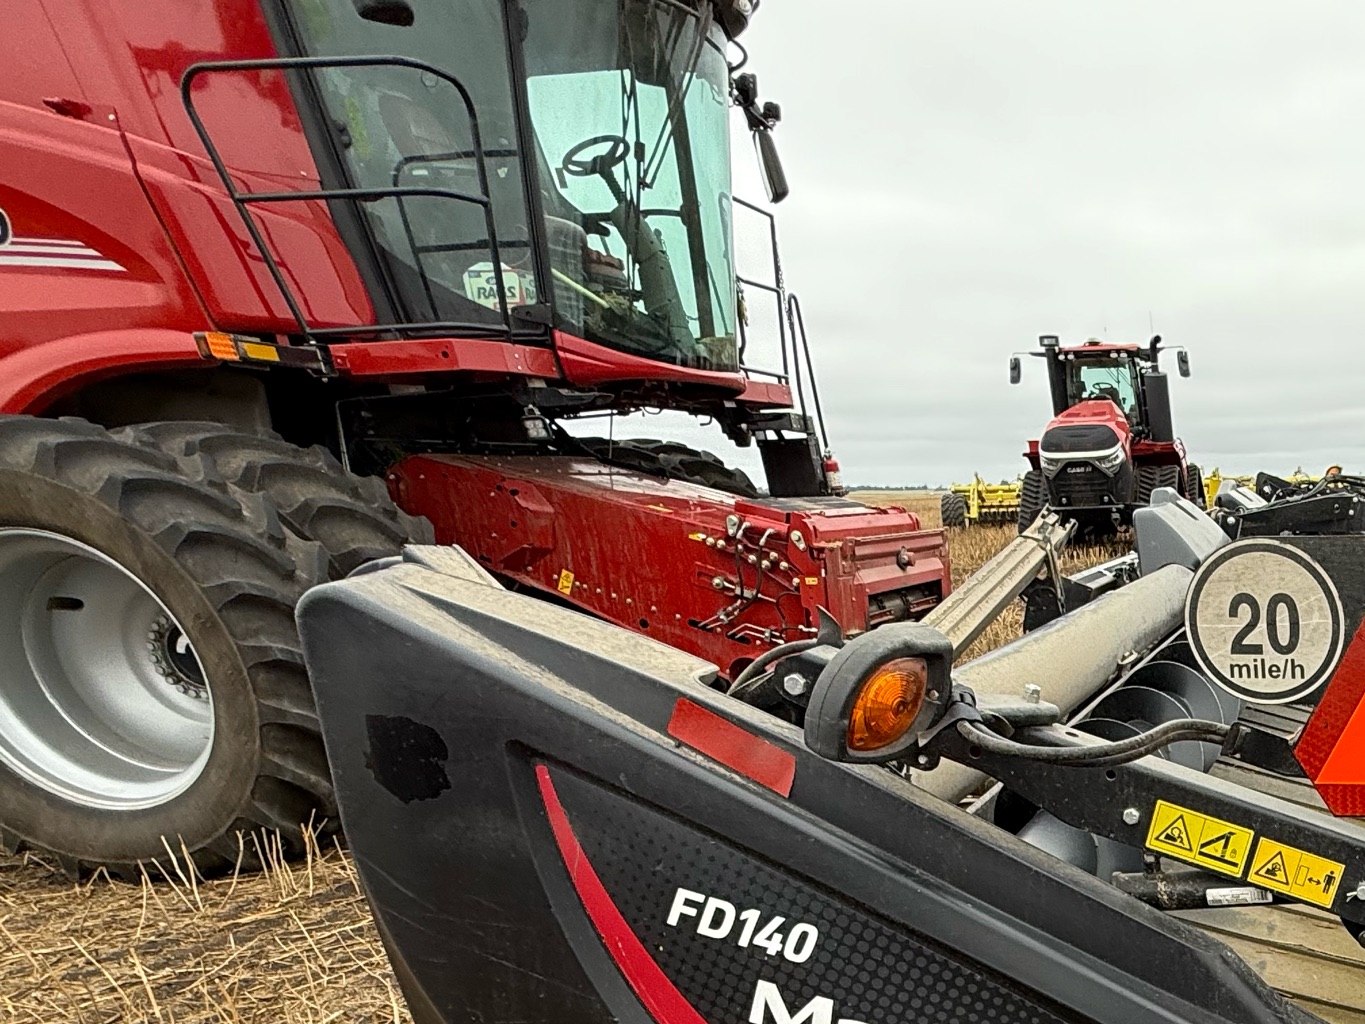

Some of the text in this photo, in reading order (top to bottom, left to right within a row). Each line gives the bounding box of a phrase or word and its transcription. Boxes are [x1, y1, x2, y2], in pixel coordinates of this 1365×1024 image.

[476, 285, 517, 300] RAS
[1228, 592, 1300, 656] 20
[1229, 658, 1306, 680] mile/h
[666, 887, 819, 963] FD140
